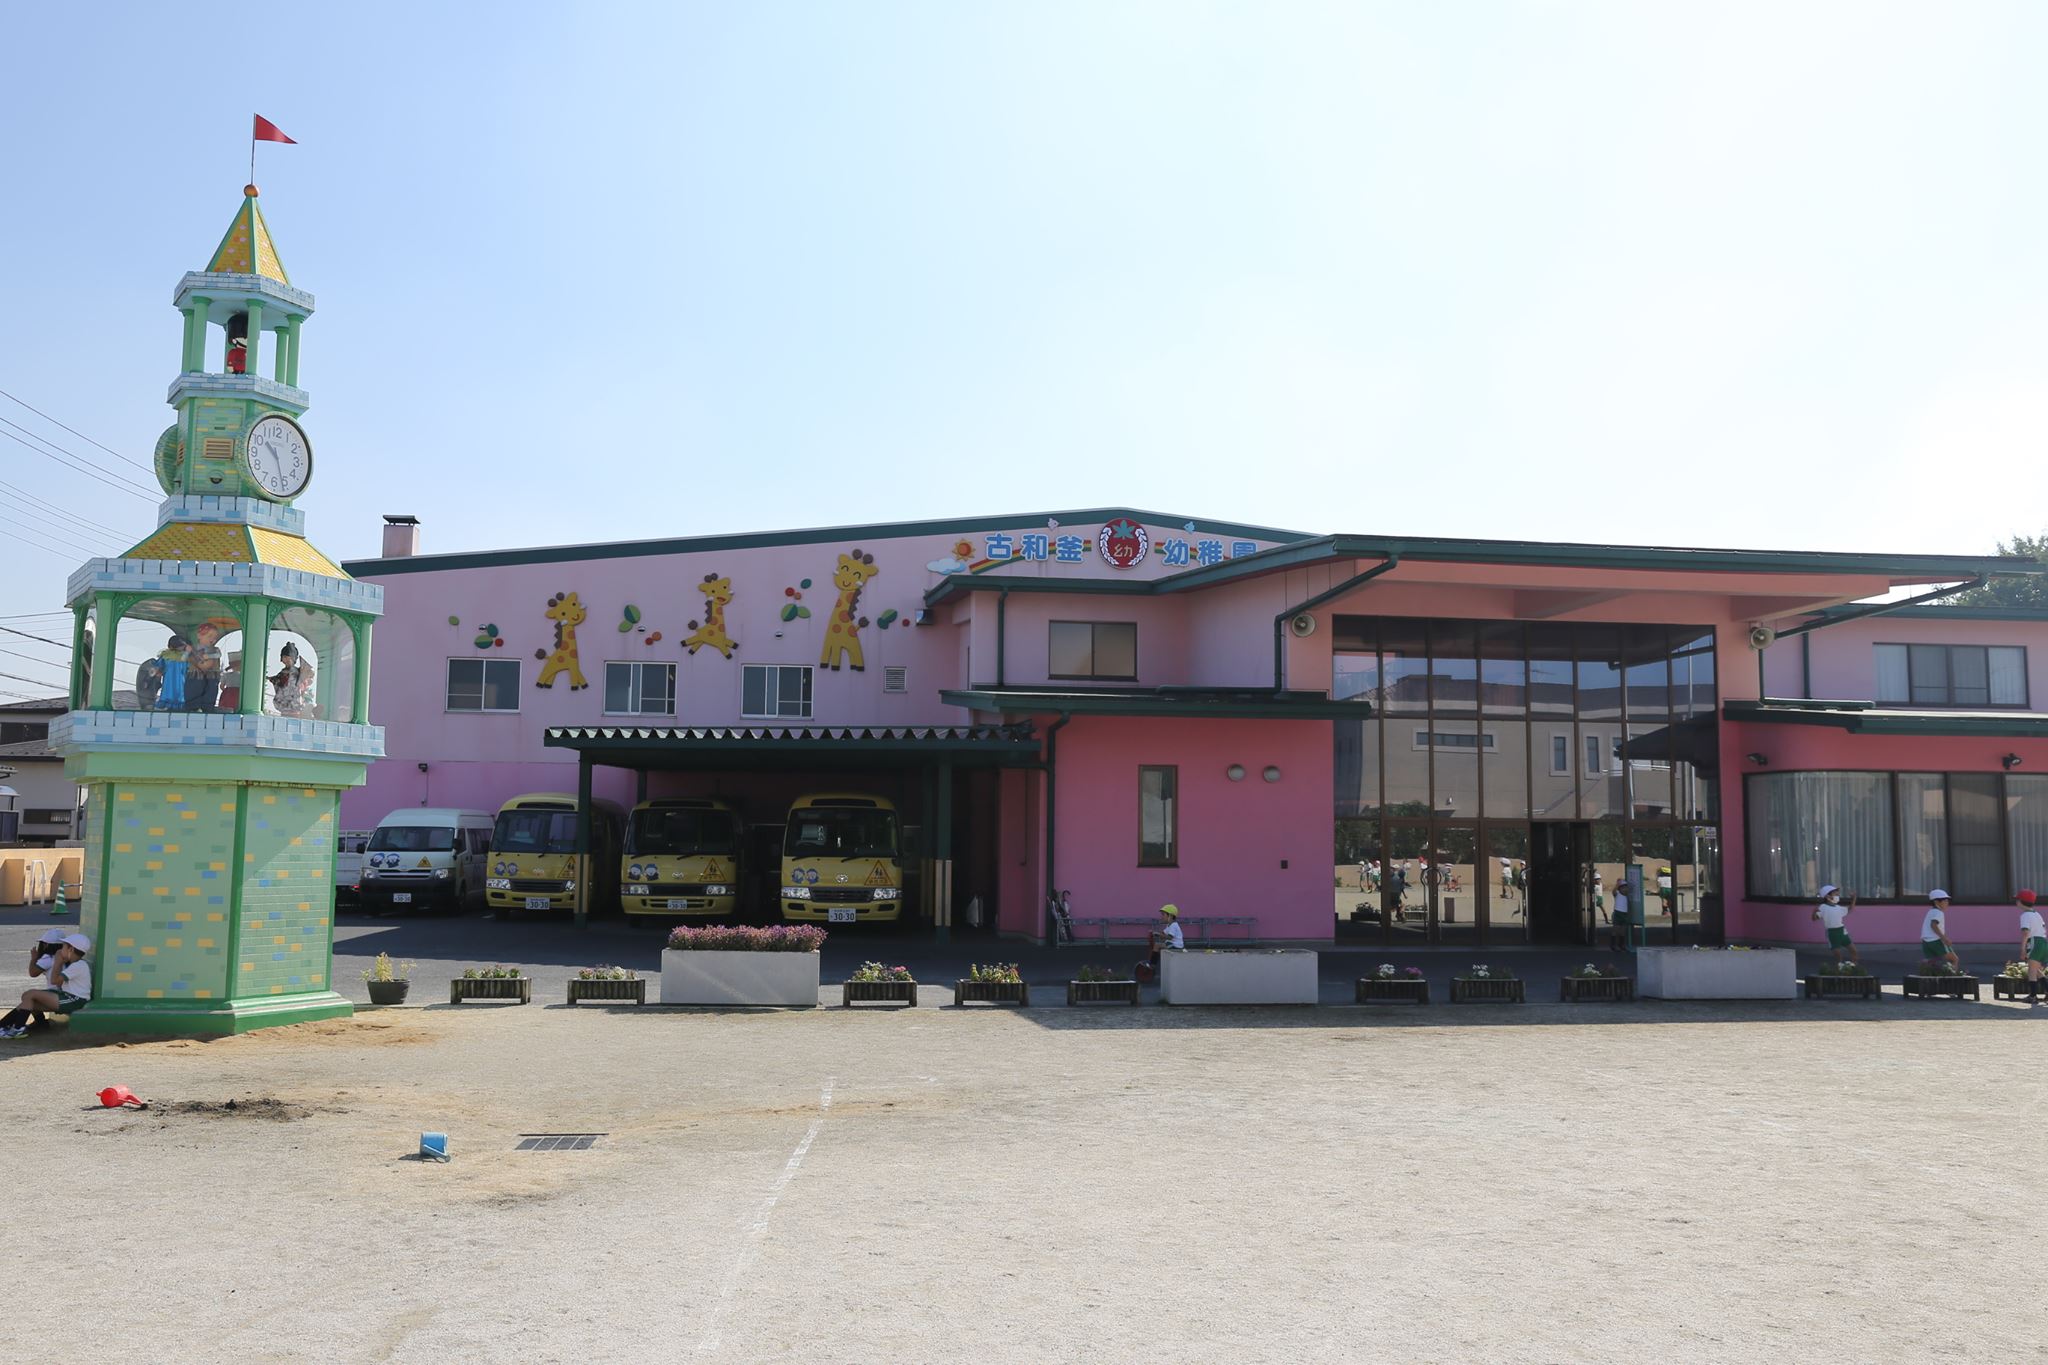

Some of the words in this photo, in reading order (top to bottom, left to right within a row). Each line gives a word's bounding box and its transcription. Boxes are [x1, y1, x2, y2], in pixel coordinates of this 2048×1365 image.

[263, 426, 271, 438] 11
[272, 426, 282, 439] 12
[253, 434, 264, 446] 10
[251, 446, 258, 457] 9
[291, 443, 298, 454] 2
[254, 459, 261, 470] 8
[293, 457, 300, 468] 3
[262, 471, 269, 482] 7
[289, 469, 296, 479] 4
[271, 477, 278, 488] 6
[282, 476, 288, 487] 5
[985, 532, 1083, 563] 古和釜
